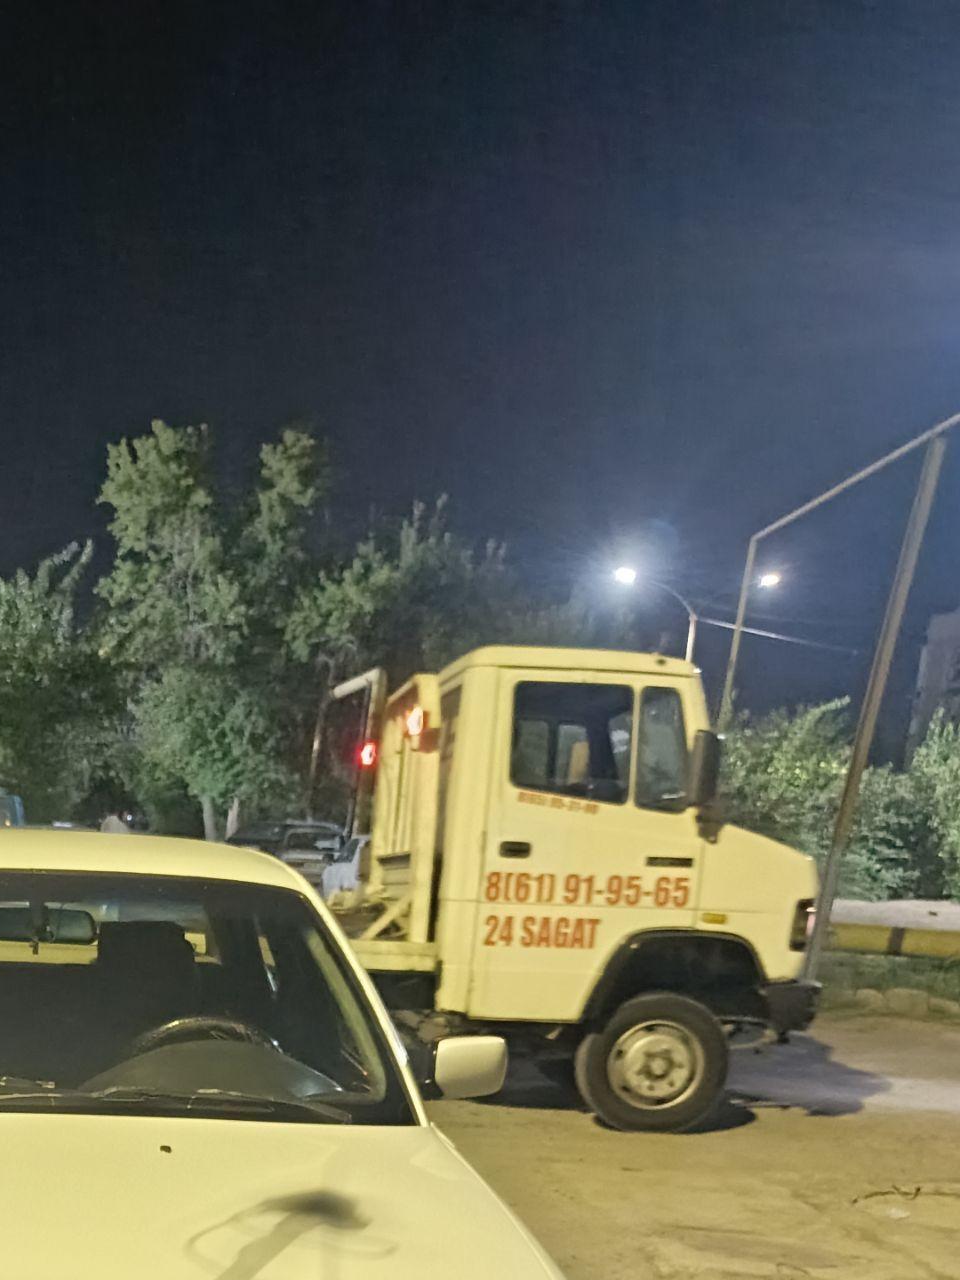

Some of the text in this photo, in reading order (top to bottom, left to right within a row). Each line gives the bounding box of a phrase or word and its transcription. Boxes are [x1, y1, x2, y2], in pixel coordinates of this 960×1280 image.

[485, 871, 690, 908] 8(61) 91-95-65
[483, 914, 601, 949] 24 SAGAT
